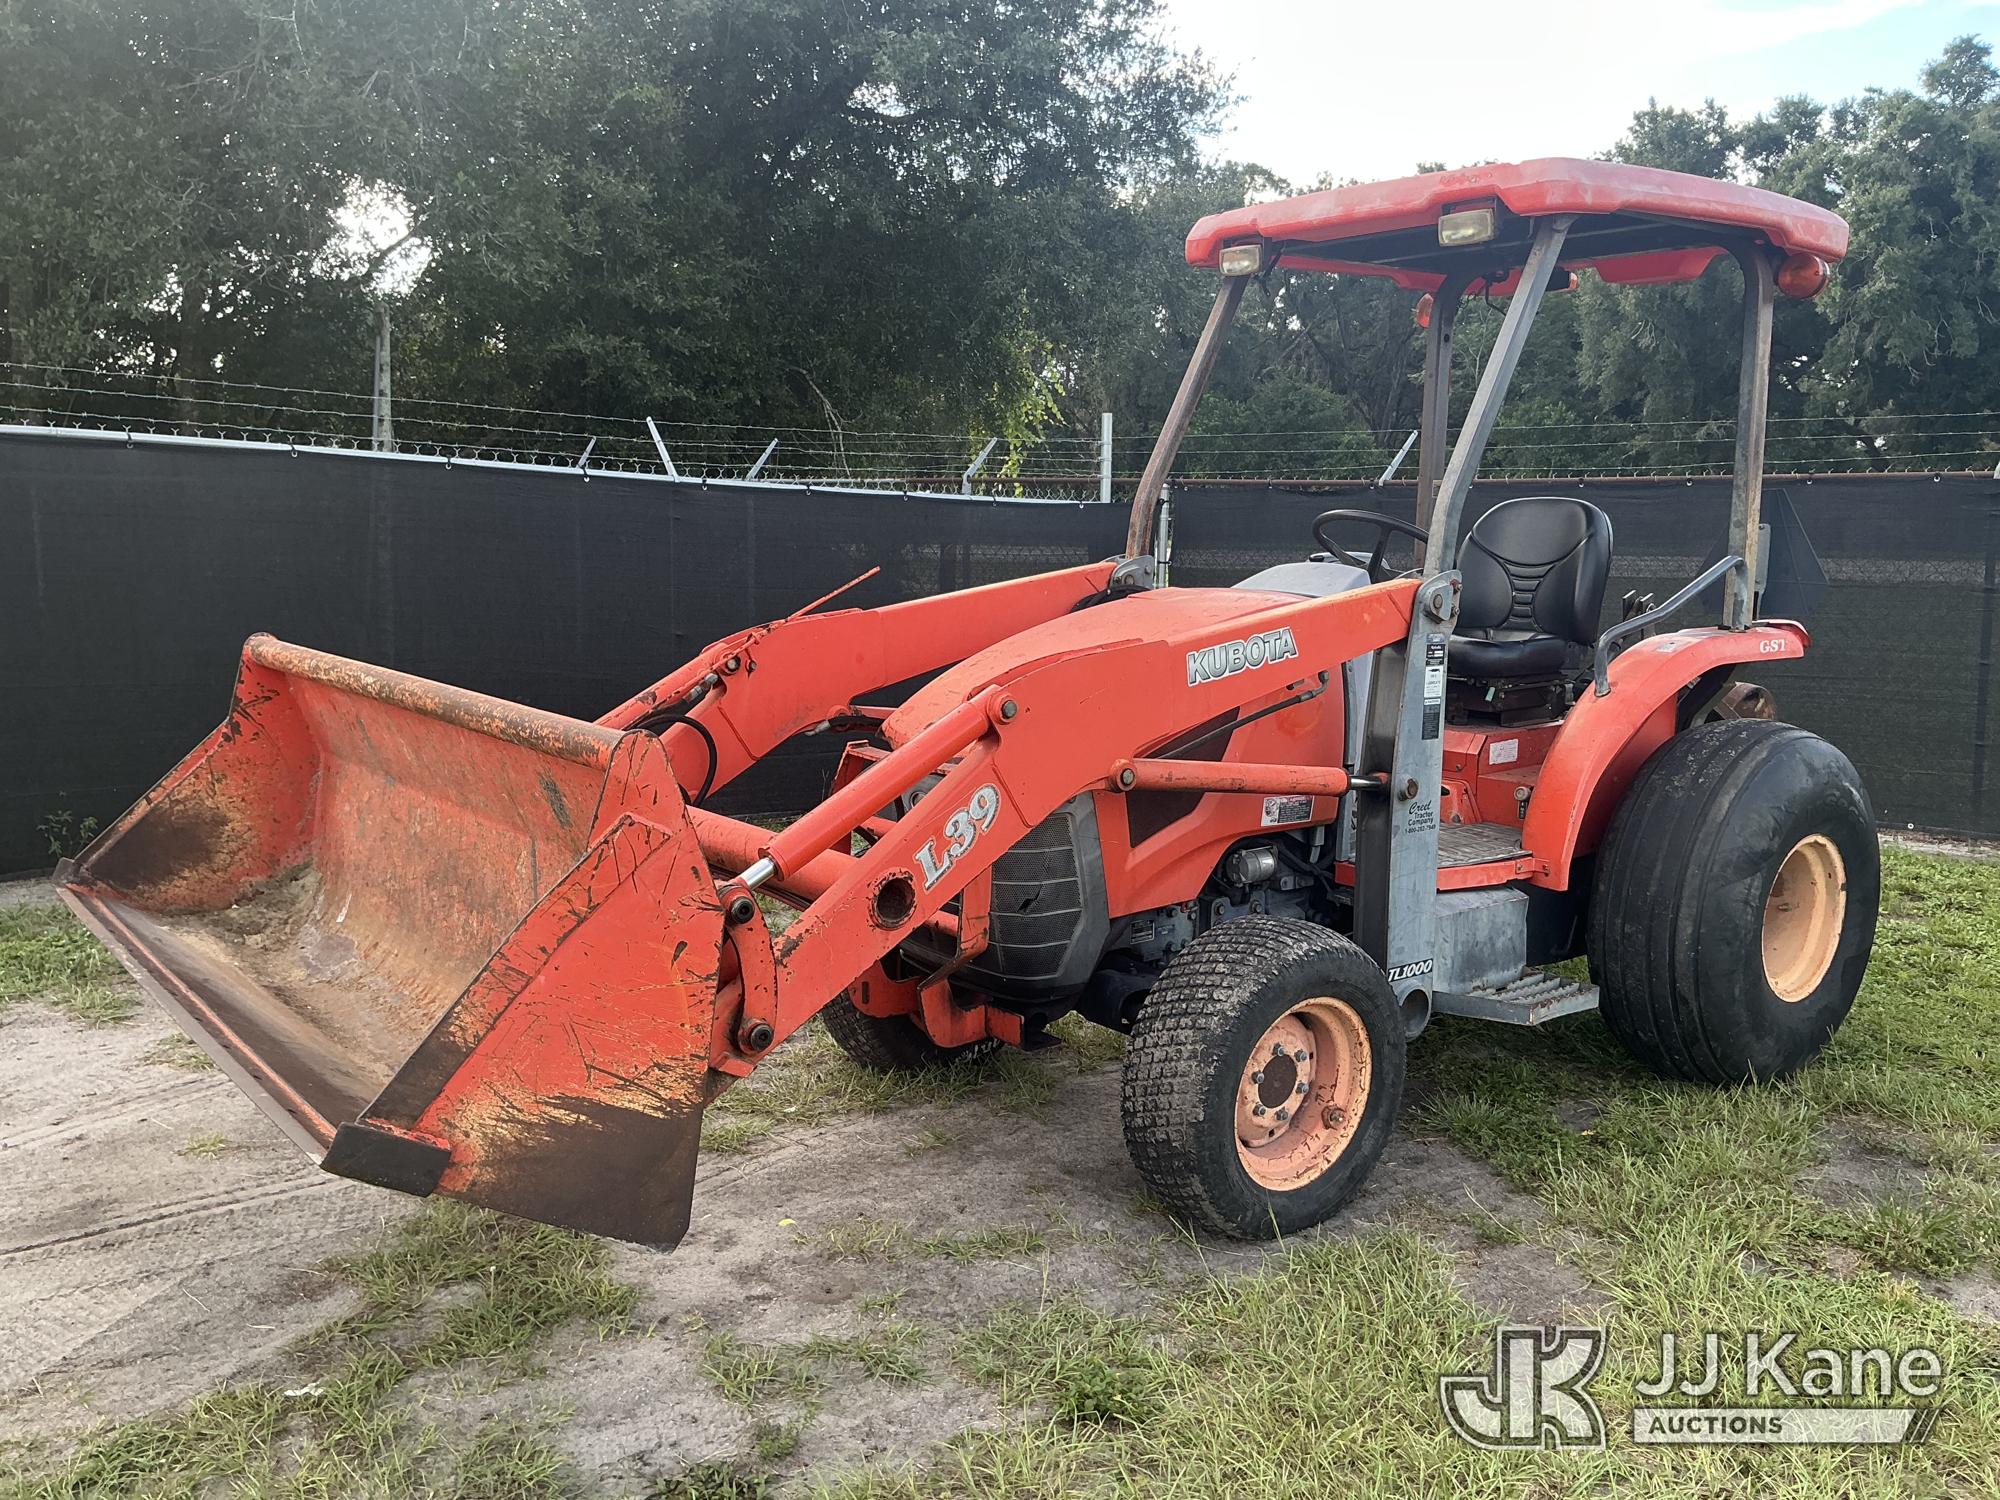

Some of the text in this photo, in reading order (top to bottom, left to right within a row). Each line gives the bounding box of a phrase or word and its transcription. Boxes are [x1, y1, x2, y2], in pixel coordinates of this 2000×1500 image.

[1187, 627, 1298, 686] KUBOTA
[1408, 817, 1434, 826] Company
[1414, 811, 1434, 819] Tractor
[914, 783, 1000, 890] L39
[1388, 959, 1433, 982] TL1000
